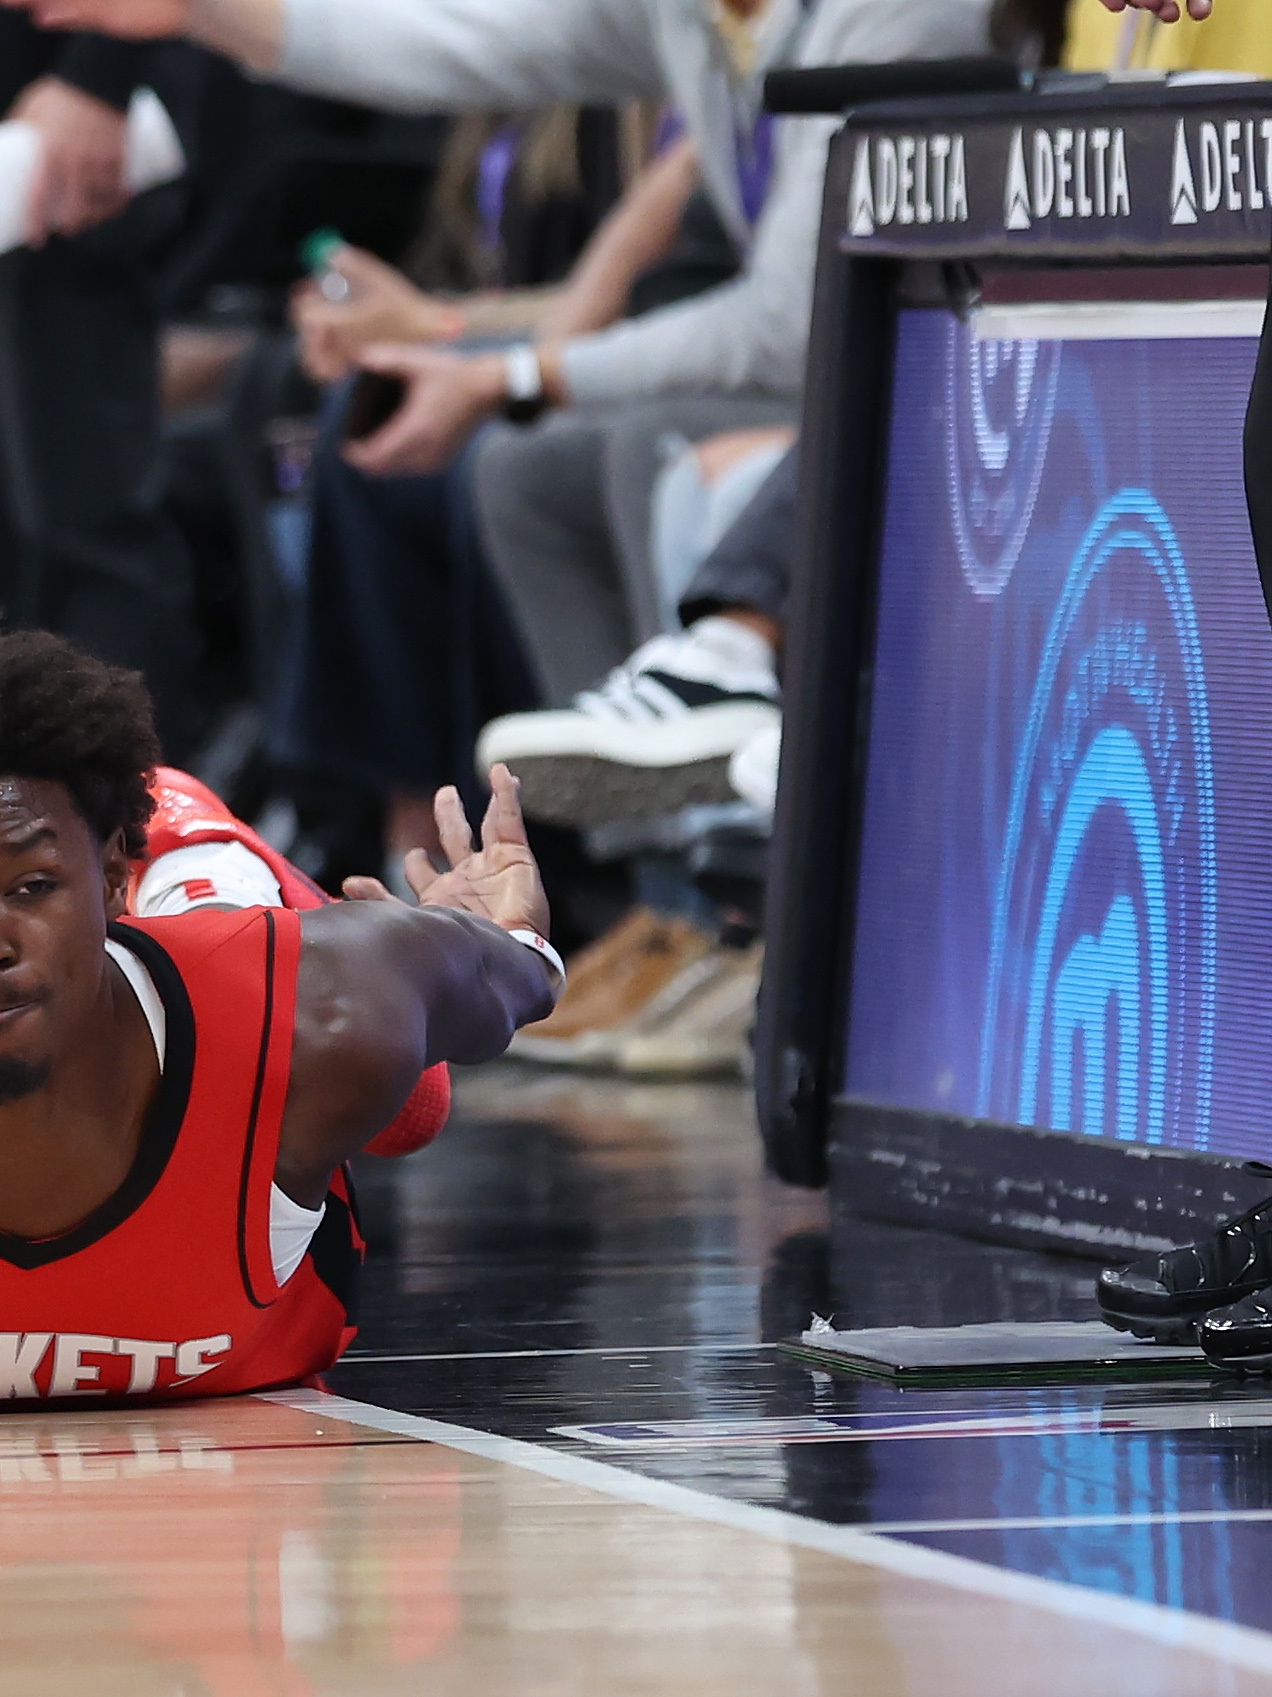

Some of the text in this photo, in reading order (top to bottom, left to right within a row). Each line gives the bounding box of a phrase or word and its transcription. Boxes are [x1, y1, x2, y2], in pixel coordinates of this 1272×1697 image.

[875, 133, 968, 225] DELTA
[1033, 127, 1130, 218] DELTA
[1199, 118, 1272, 212] DELT
